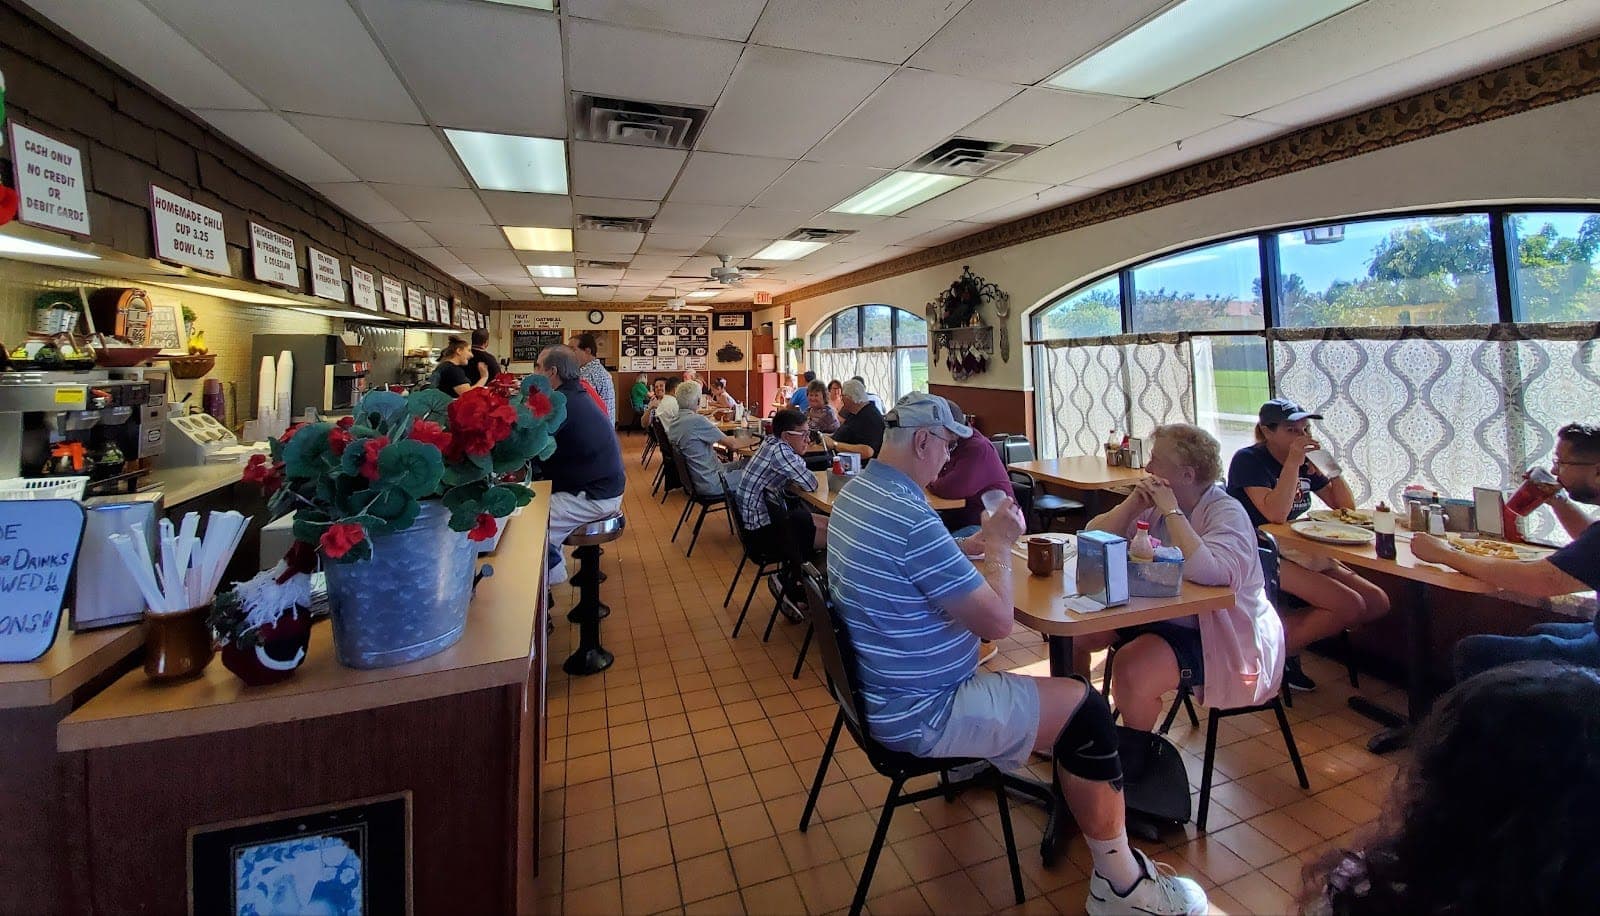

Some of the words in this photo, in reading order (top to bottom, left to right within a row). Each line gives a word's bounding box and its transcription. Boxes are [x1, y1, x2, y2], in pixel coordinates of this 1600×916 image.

[24, 140, 48, 157] CASH
[50, 150, 72, 166] ONLY
[27, 163, 41, 176] NO
[44, 168, 76, 188] CREDIT
[48, 187, 61, 200] OR
[26, 197, 55, 215] DEBIT
[57, 206, 84, 222] CARDS
[155, 197, 202, 224] HOMEMADE
[204, 215, 222, 231] CHILI
[175, 222, 191, 237] CUP
[193, 228, 209, 242] 3.25
[174, 239, 196, 254] BOWL
[198, 246, 214, 260] 4.25
[758, 293, 769, 303] EXIT
